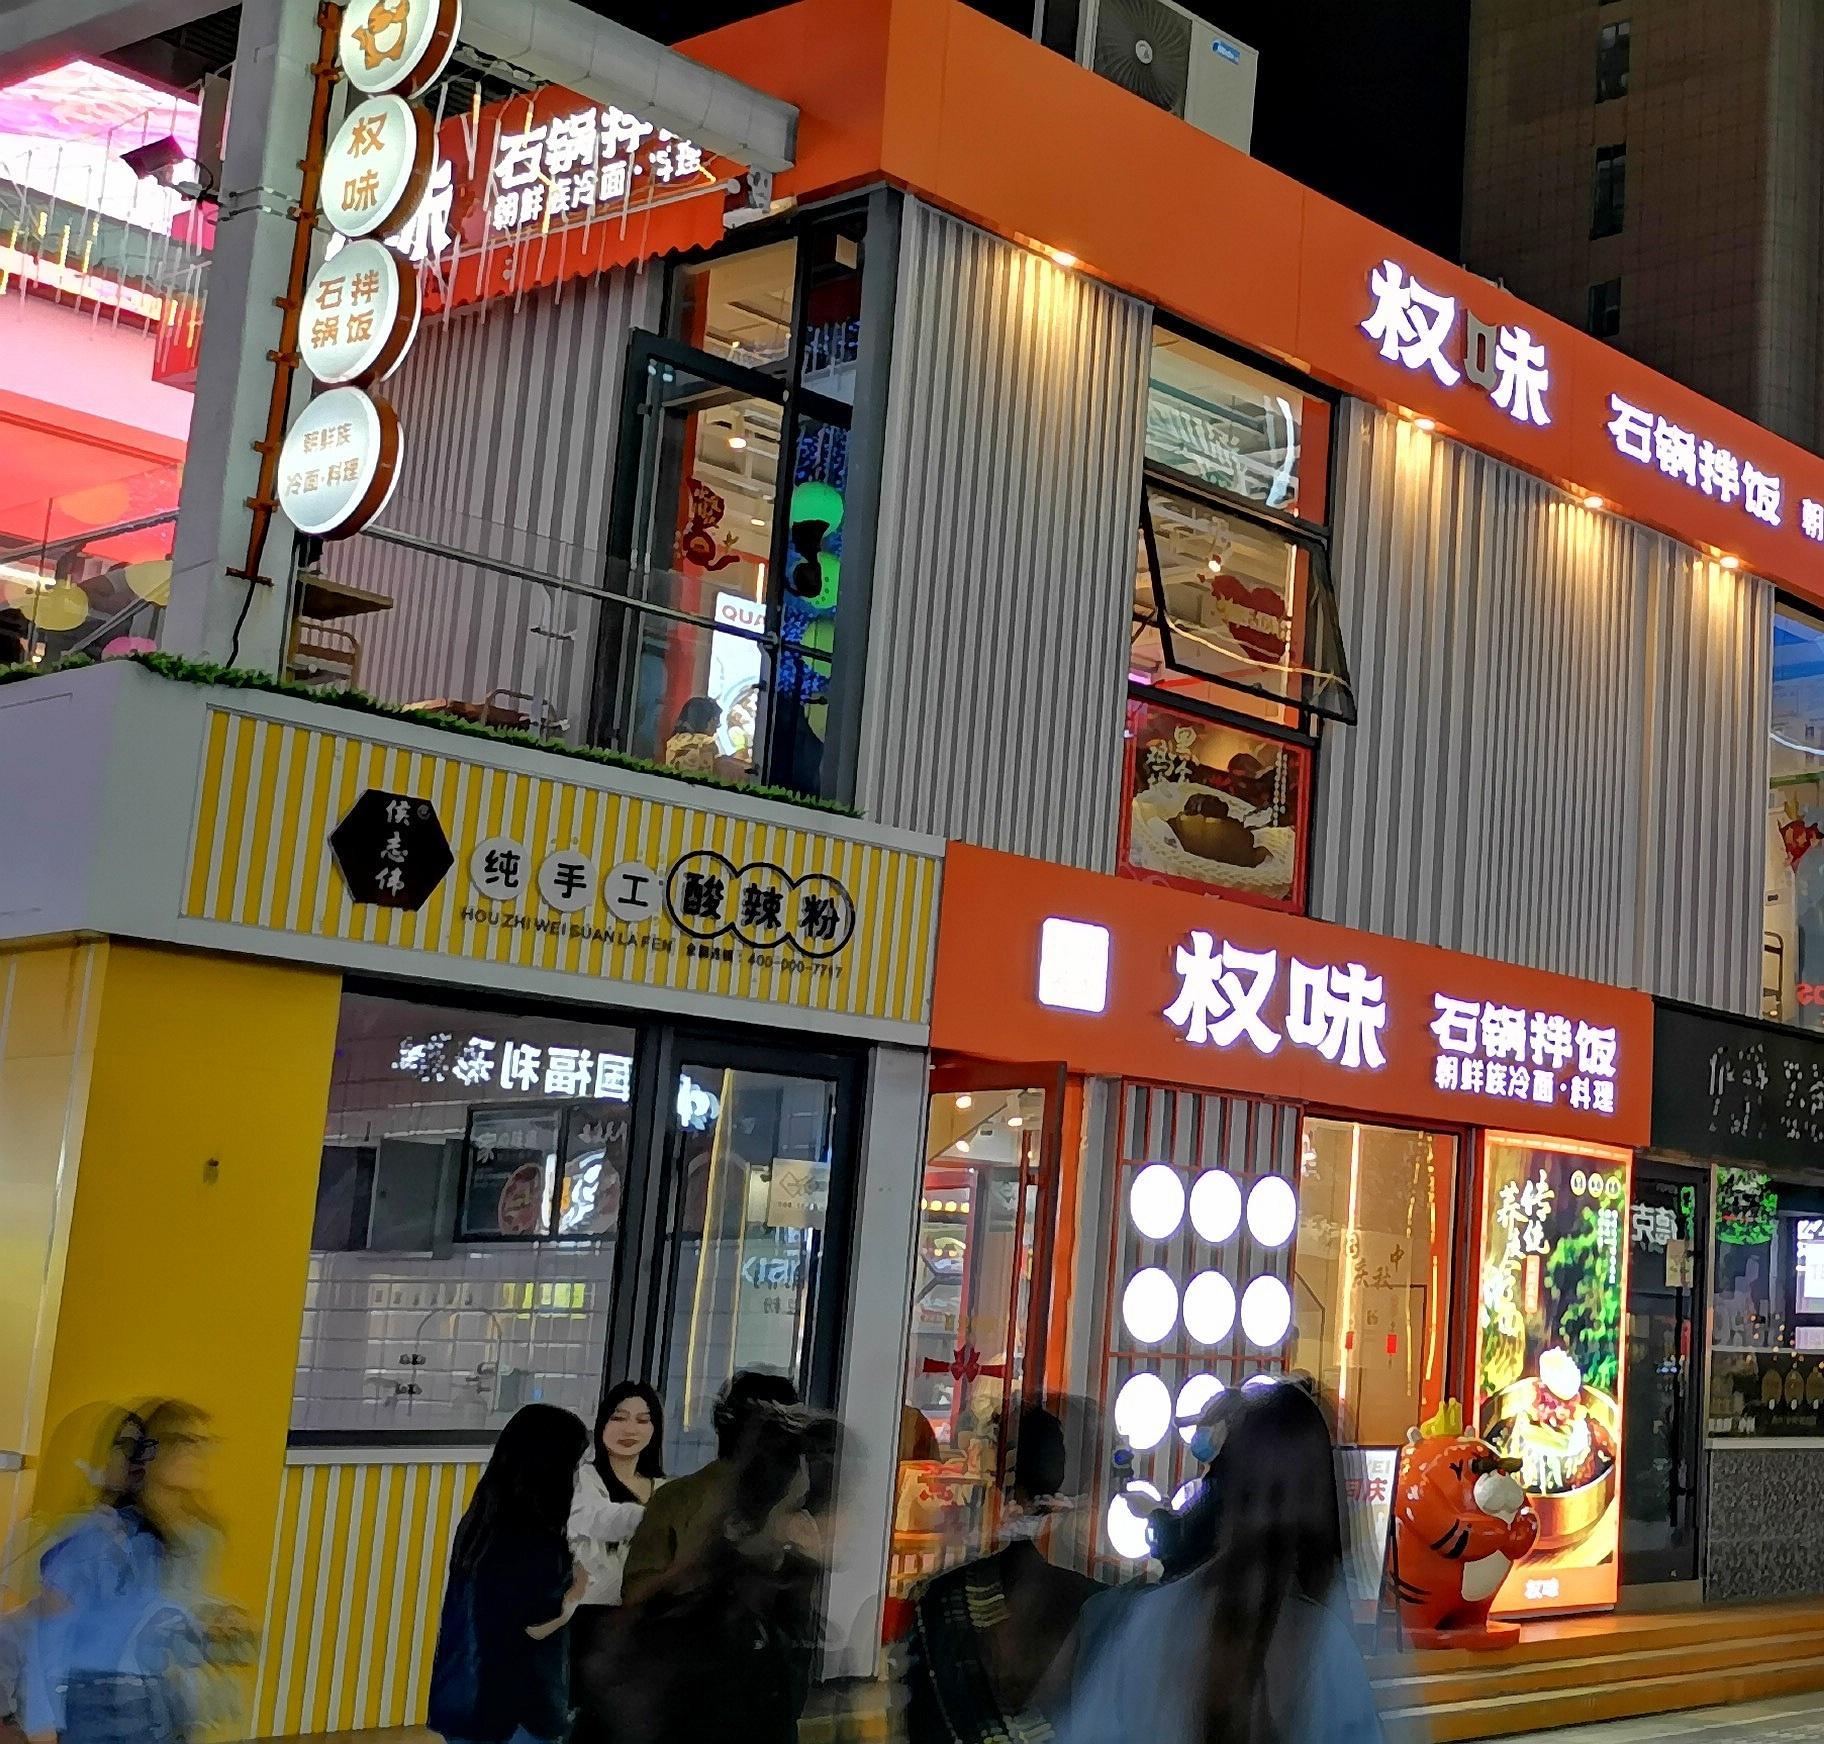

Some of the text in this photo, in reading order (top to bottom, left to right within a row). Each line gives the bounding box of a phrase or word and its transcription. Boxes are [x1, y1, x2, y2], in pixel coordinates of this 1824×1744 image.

[343, 111, 388, 213] 权味
[1360, 258, 1552, 426] 权味
[1608, 392, 1784, 528] 石锅拌饭
[461, 906, 499, 926] HOU
[500, 913, 531, 931] ZHI
[534, 917, 567, 937] WEI
[1162, 930, 1386, 1070] 权味
[1430, 990, 1618, 1078] 石锅拌饭
